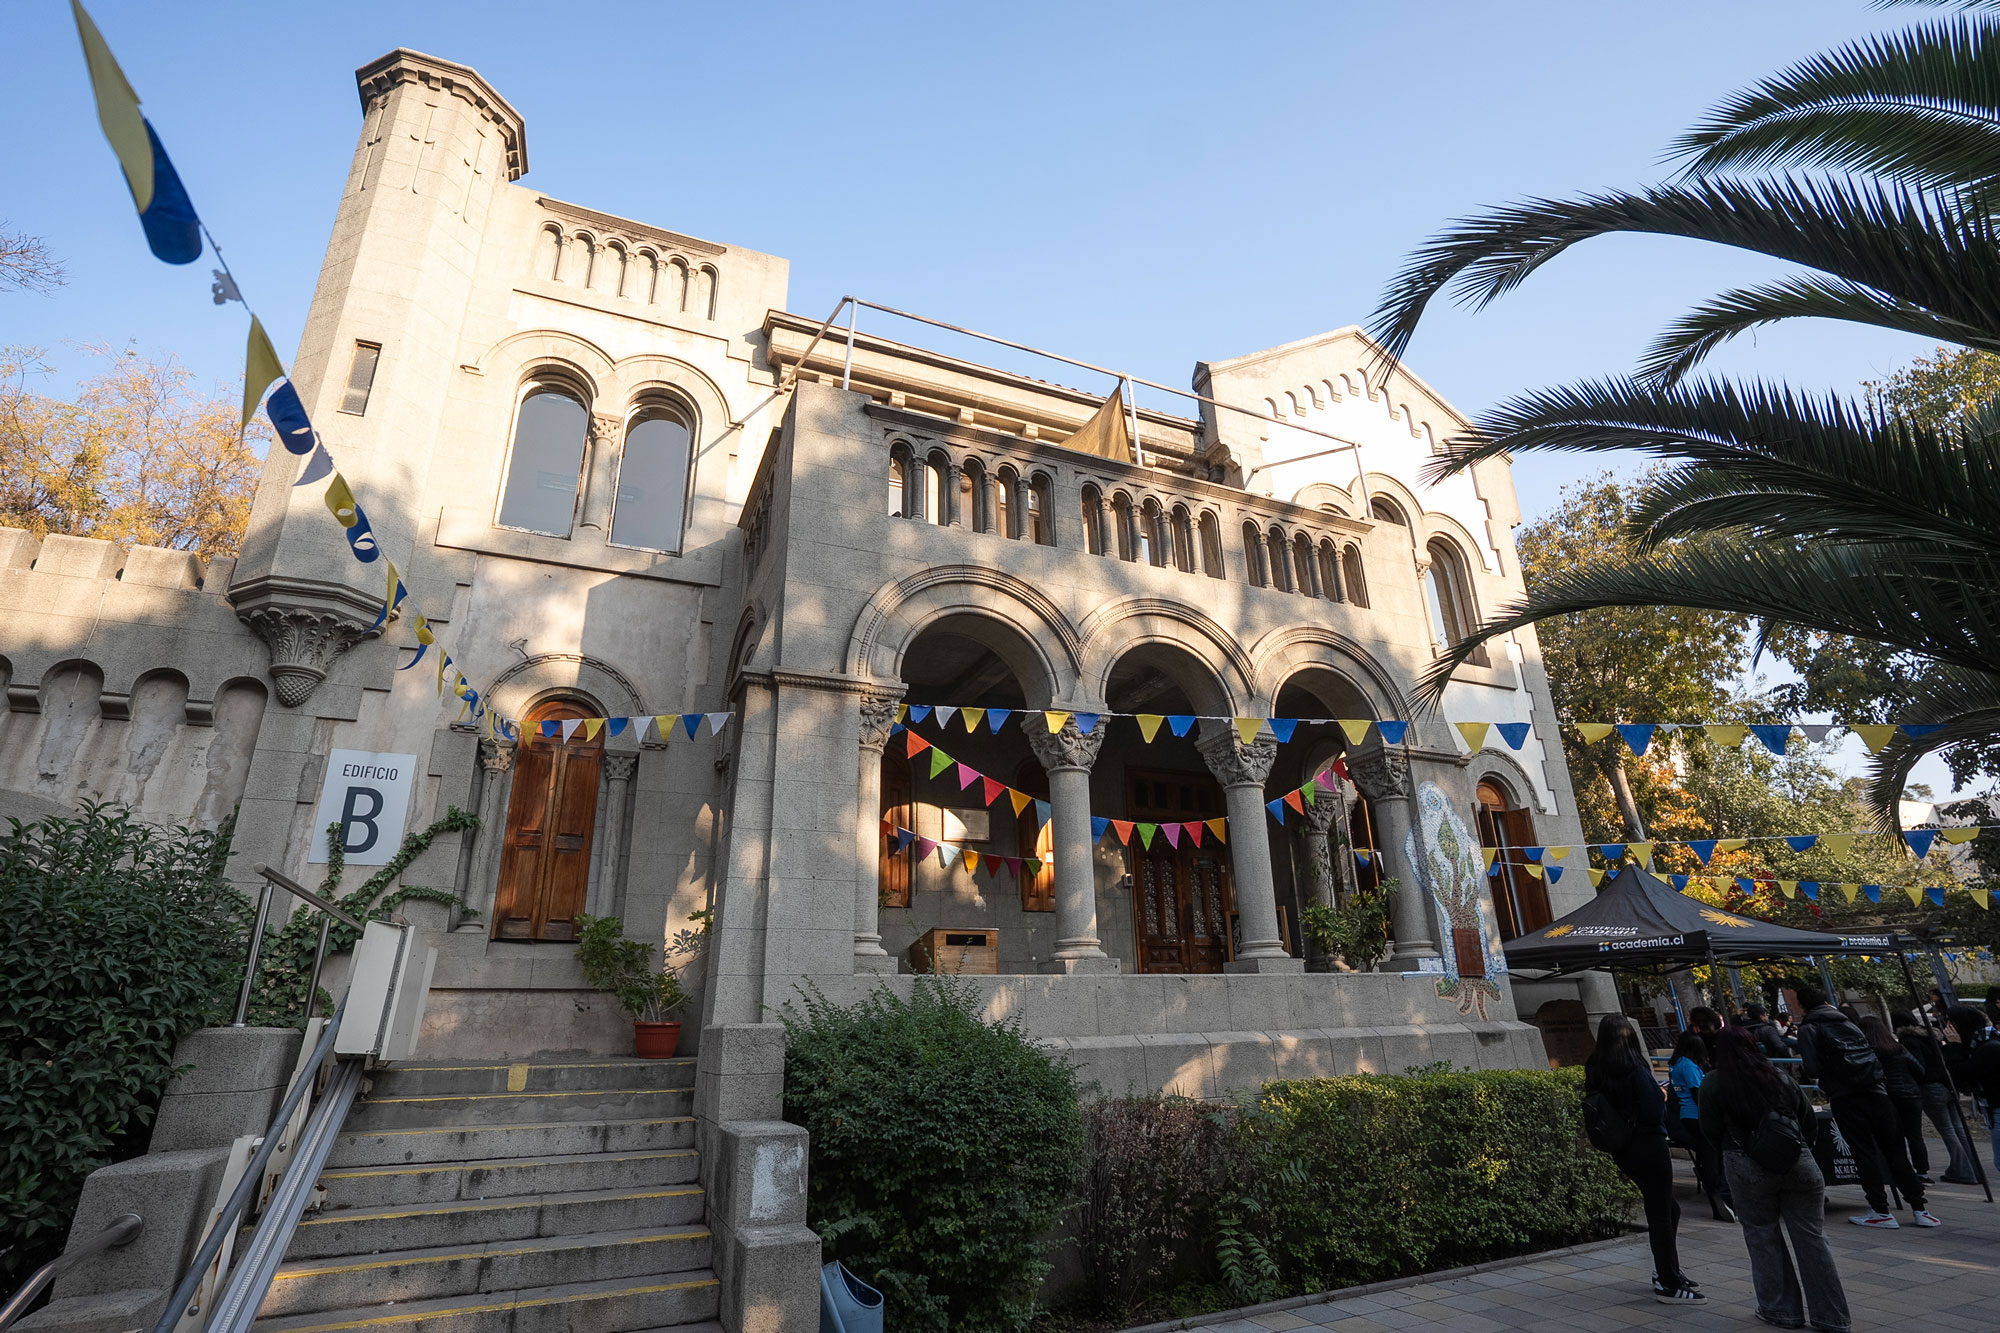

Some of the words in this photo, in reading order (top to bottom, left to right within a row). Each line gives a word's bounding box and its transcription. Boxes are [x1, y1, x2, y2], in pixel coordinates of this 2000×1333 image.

[342, 764, 398, 781] EDIFICIO
[339, 786, 384, 854] B
[1612, 935, 1684, 950] academia.cl
[1848, 936, 1890, 946] academia.cl
